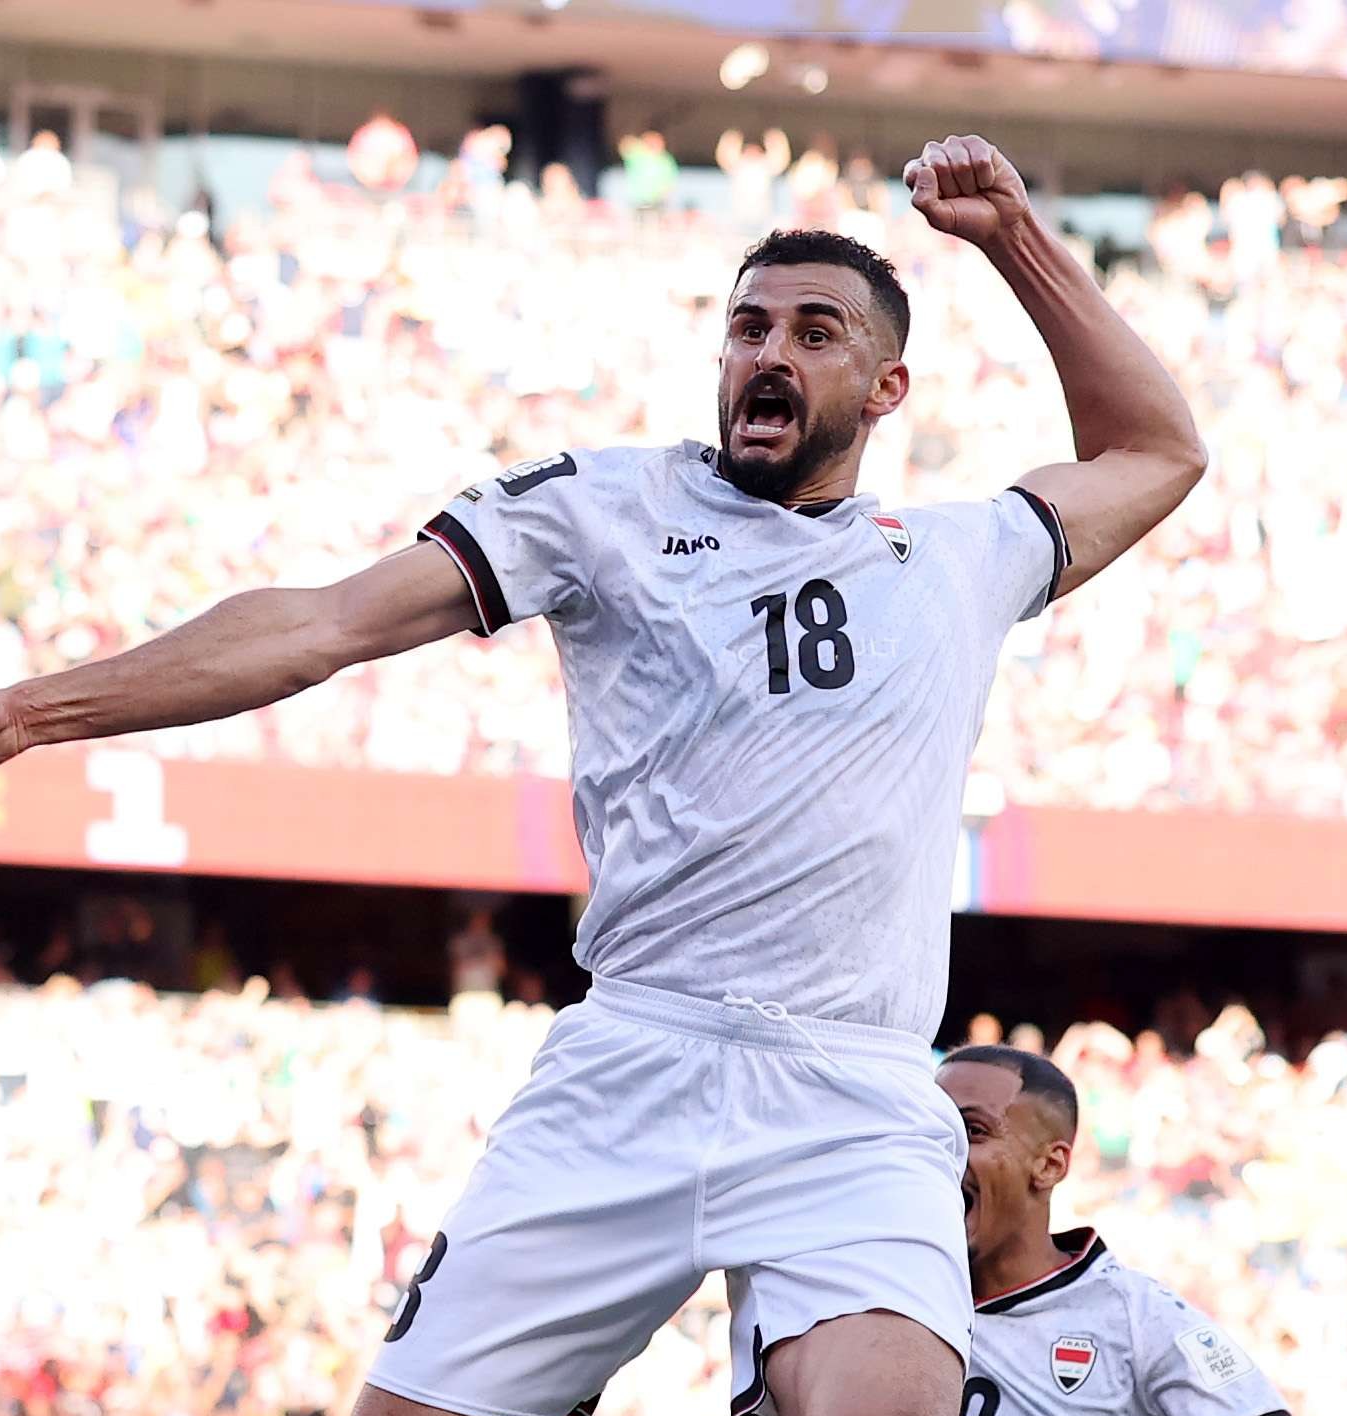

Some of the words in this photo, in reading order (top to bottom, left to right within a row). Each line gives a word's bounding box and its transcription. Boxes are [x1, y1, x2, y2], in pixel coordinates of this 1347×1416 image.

[662, 535, 720, 556] JAKO
[750, 578, 855, 695] 18
[85, 750, 188, 866] 1
